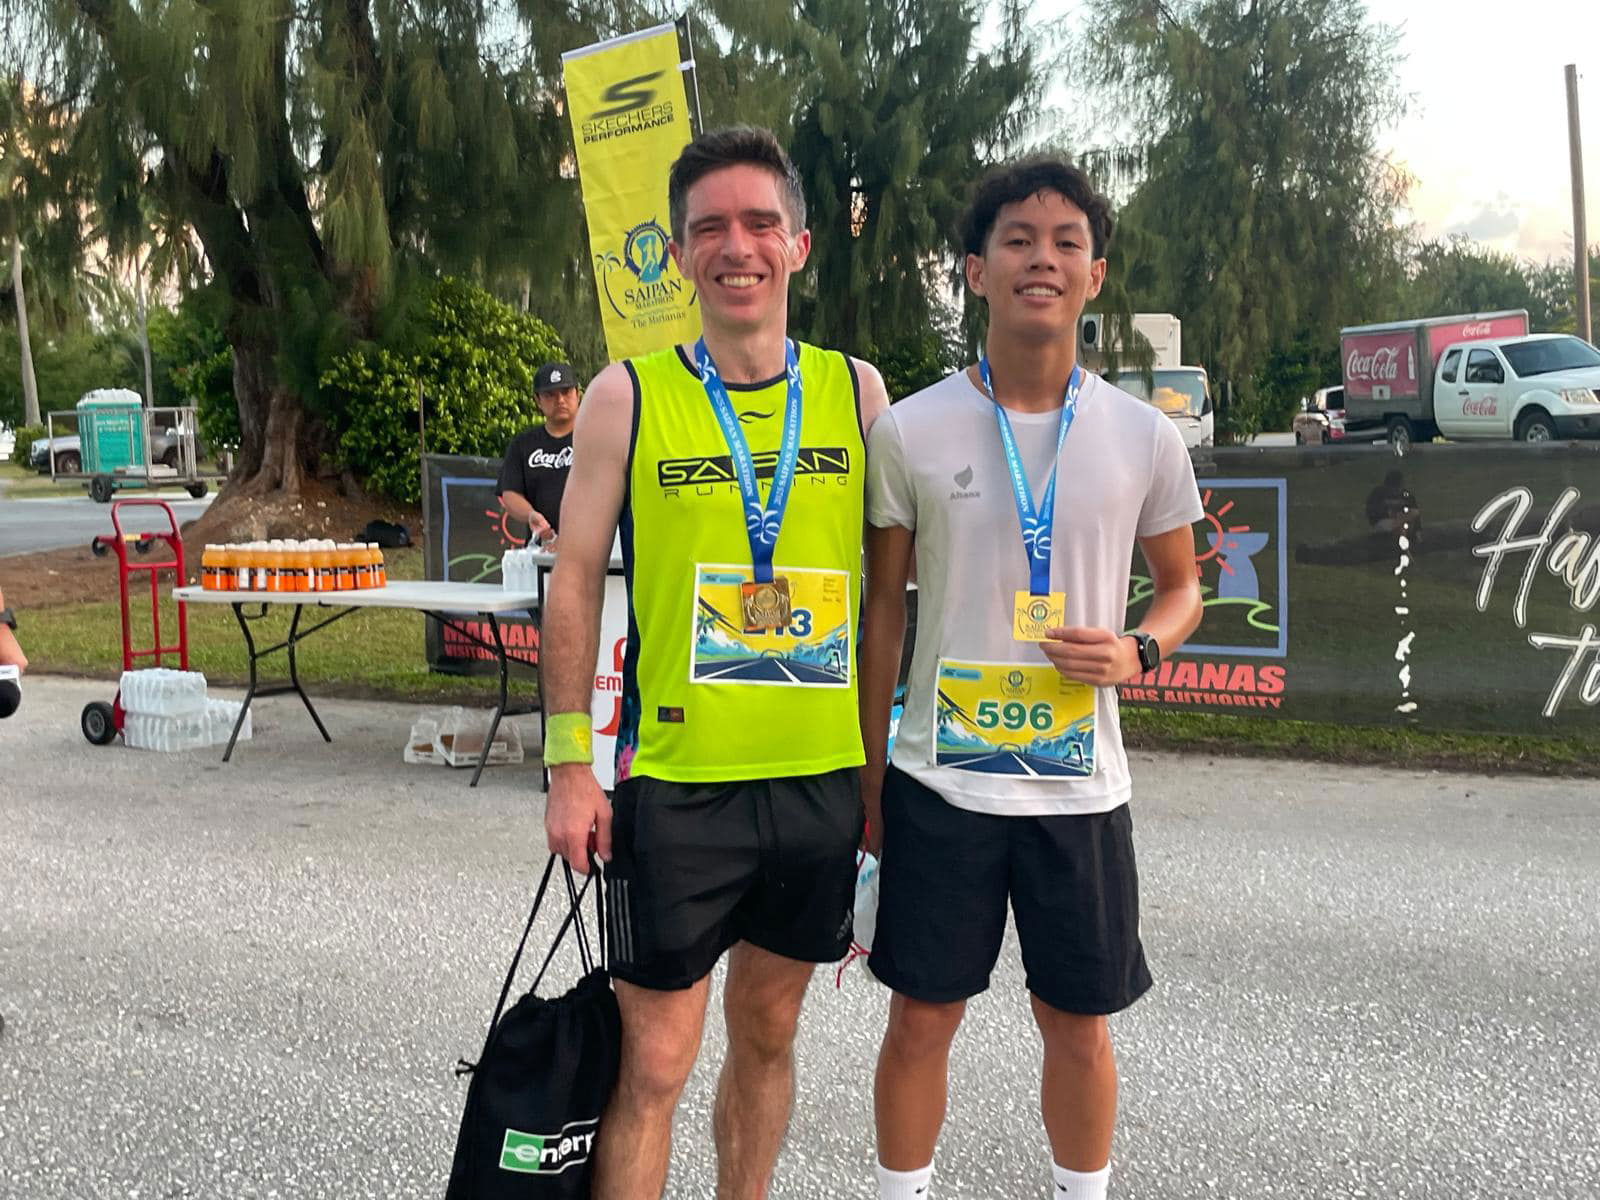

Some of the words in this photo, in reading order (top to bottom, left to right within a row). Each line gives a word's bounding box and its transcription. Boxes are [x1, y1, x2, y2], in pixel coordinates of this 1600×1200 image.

[581, 101, 674, 136] SKECHERS
[583, 114, 675, 145] PERFORMANCE
[624, 278, 682, 305] SAIPAN
[444, 620, 541, 648] MARIAN
[1164, 690, 1281, 709] AUTHORITY
[976, 701, 1053, 731] 596
